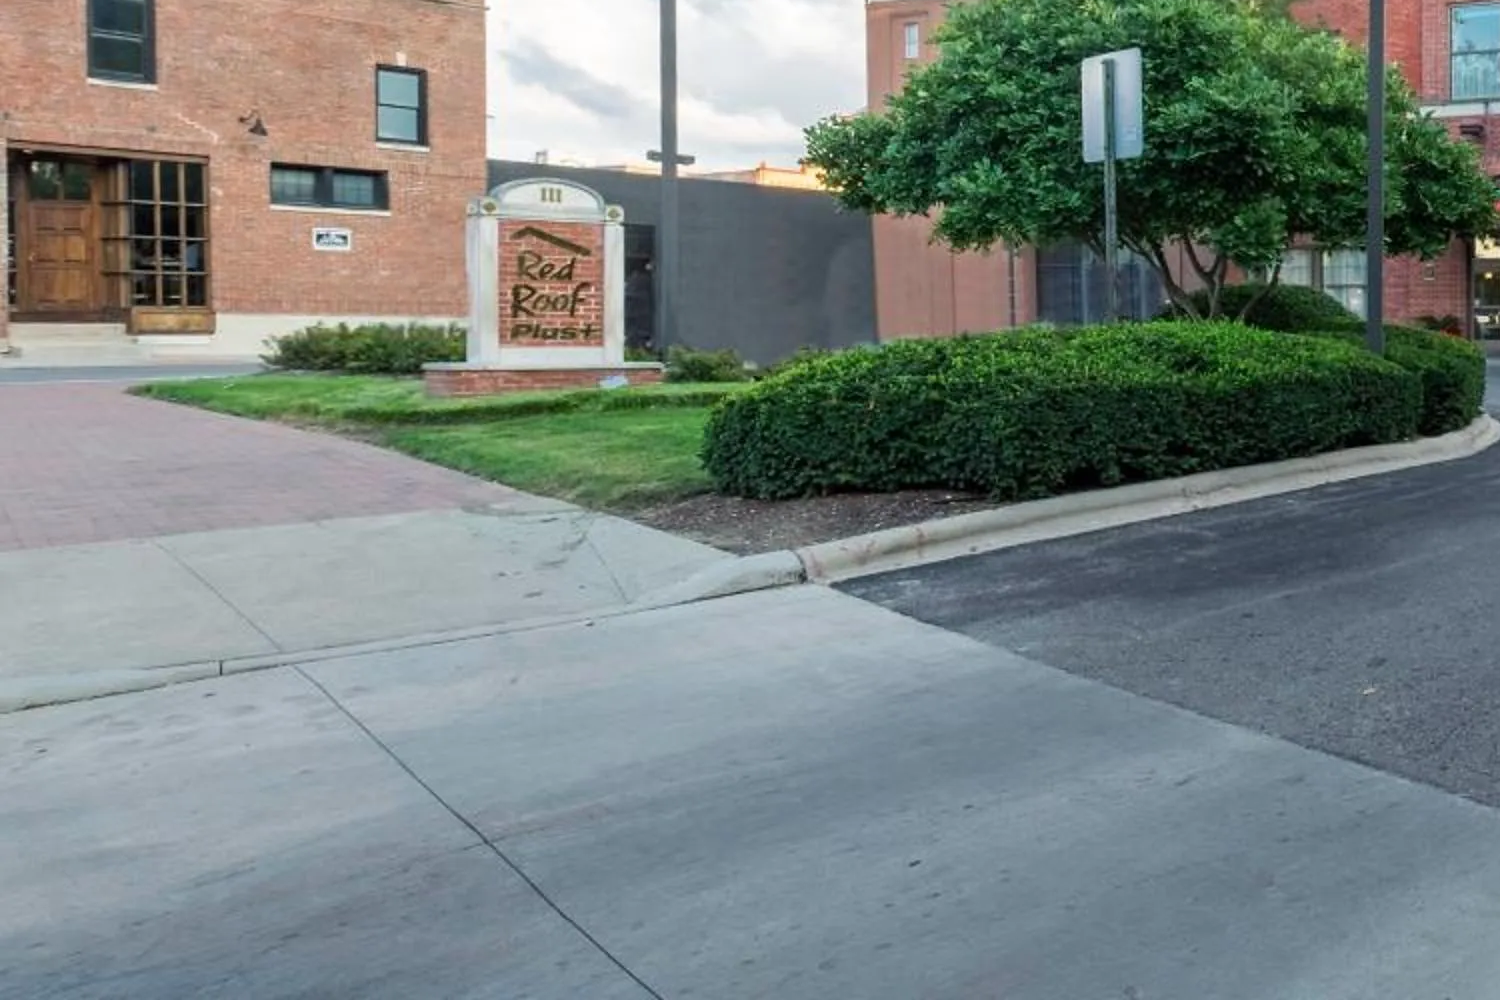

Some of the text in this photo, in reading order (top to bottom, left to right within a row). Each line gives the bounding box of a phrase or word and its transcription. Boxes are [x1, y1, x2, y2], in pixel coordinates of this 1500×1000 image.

[517, 250, 576, 281] Red
[511, 282, 591, 318] Roof
[510, 323, 601, 341] Plus+
